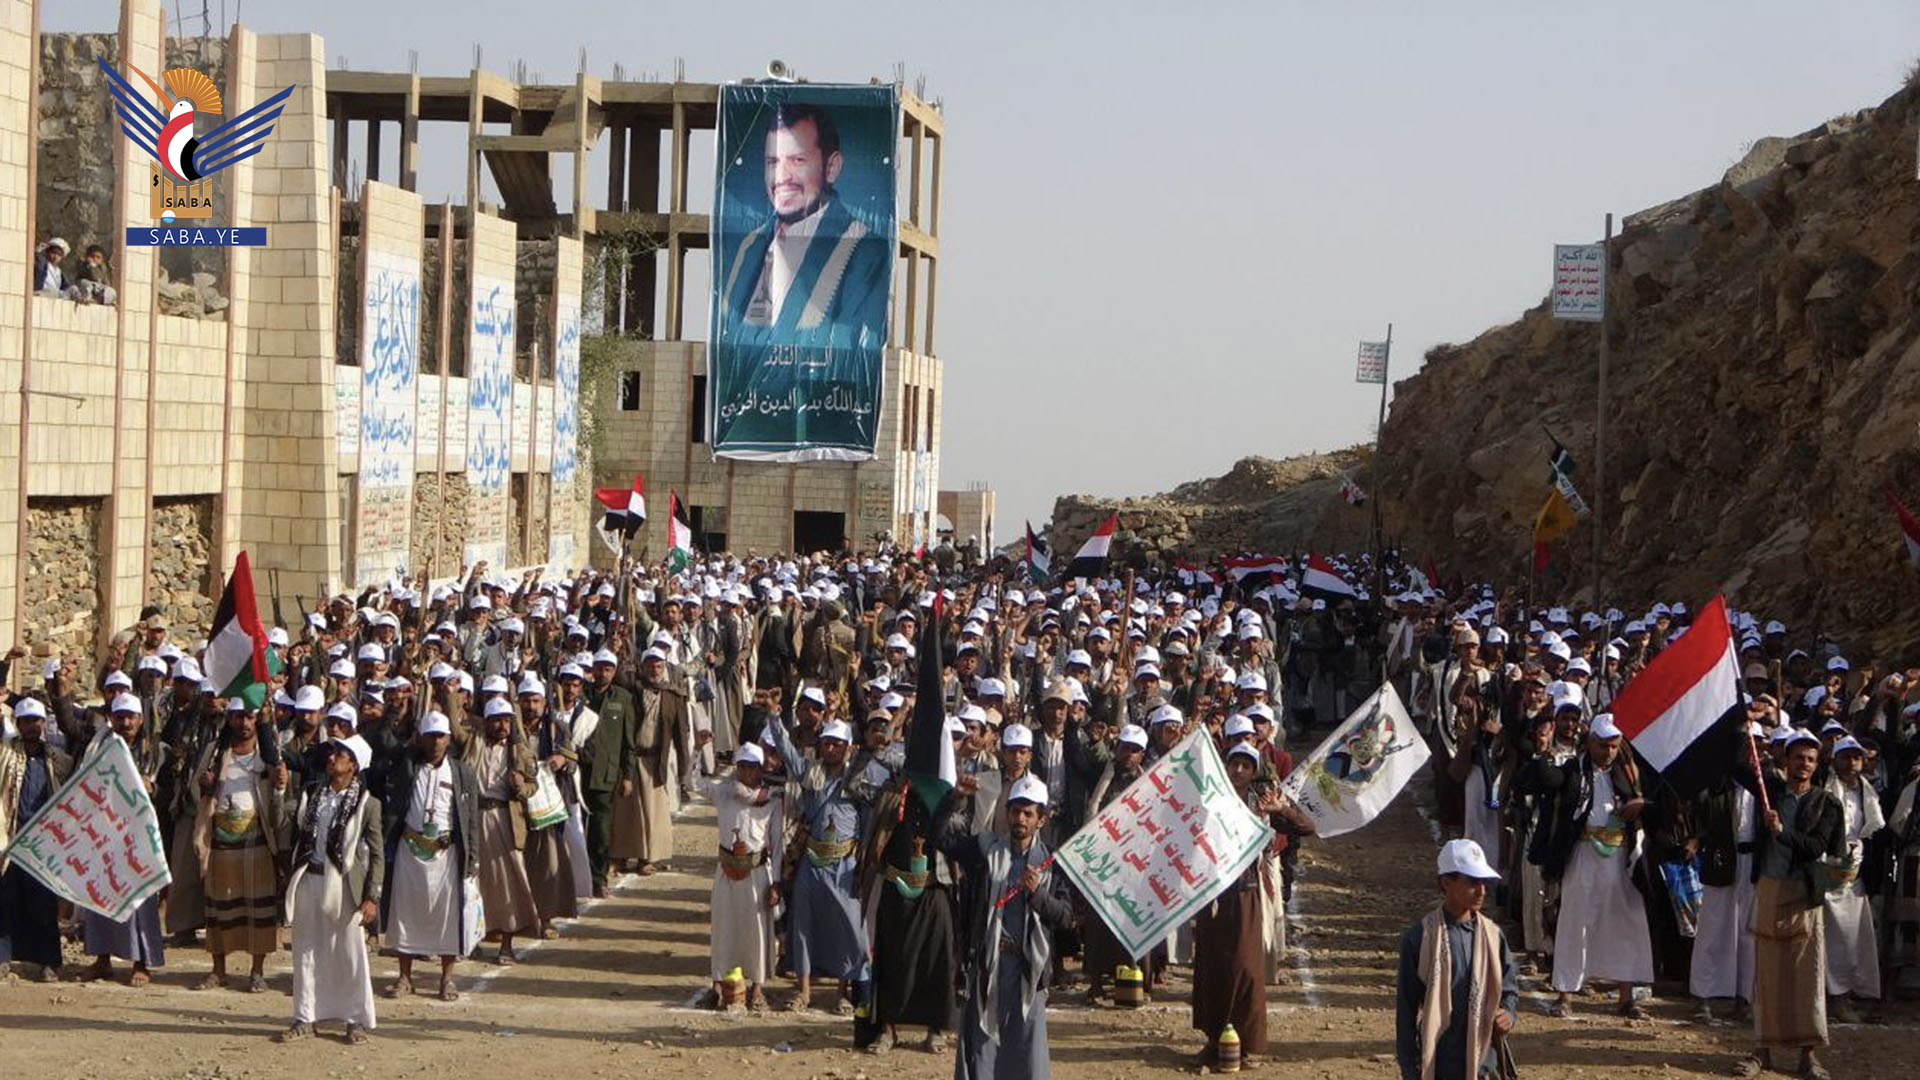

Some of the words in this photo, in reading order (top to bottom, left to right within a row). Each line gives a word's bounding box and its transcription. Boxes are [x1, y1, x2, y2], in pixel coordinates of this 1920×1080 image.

[759, 387, 797, 417] الدين
[96, 764, 149, 817] أكبر
[1169, 750, 1225, 804] أكبر
[1099, 814, 1135, 848] اليهود
[65, 855, 91, 877] على
[102, 850, 132, 898] الموت
[124, 833, 155, 879] الموت
[1122, 850, 1149, 872] على
[1164, 843, 1209, 890] الموت
[86, 875, 117, 912] اللعنة
[1104, 886, 1158, 932] النصر
[1148, 869, 1182, 911] اللعنة
